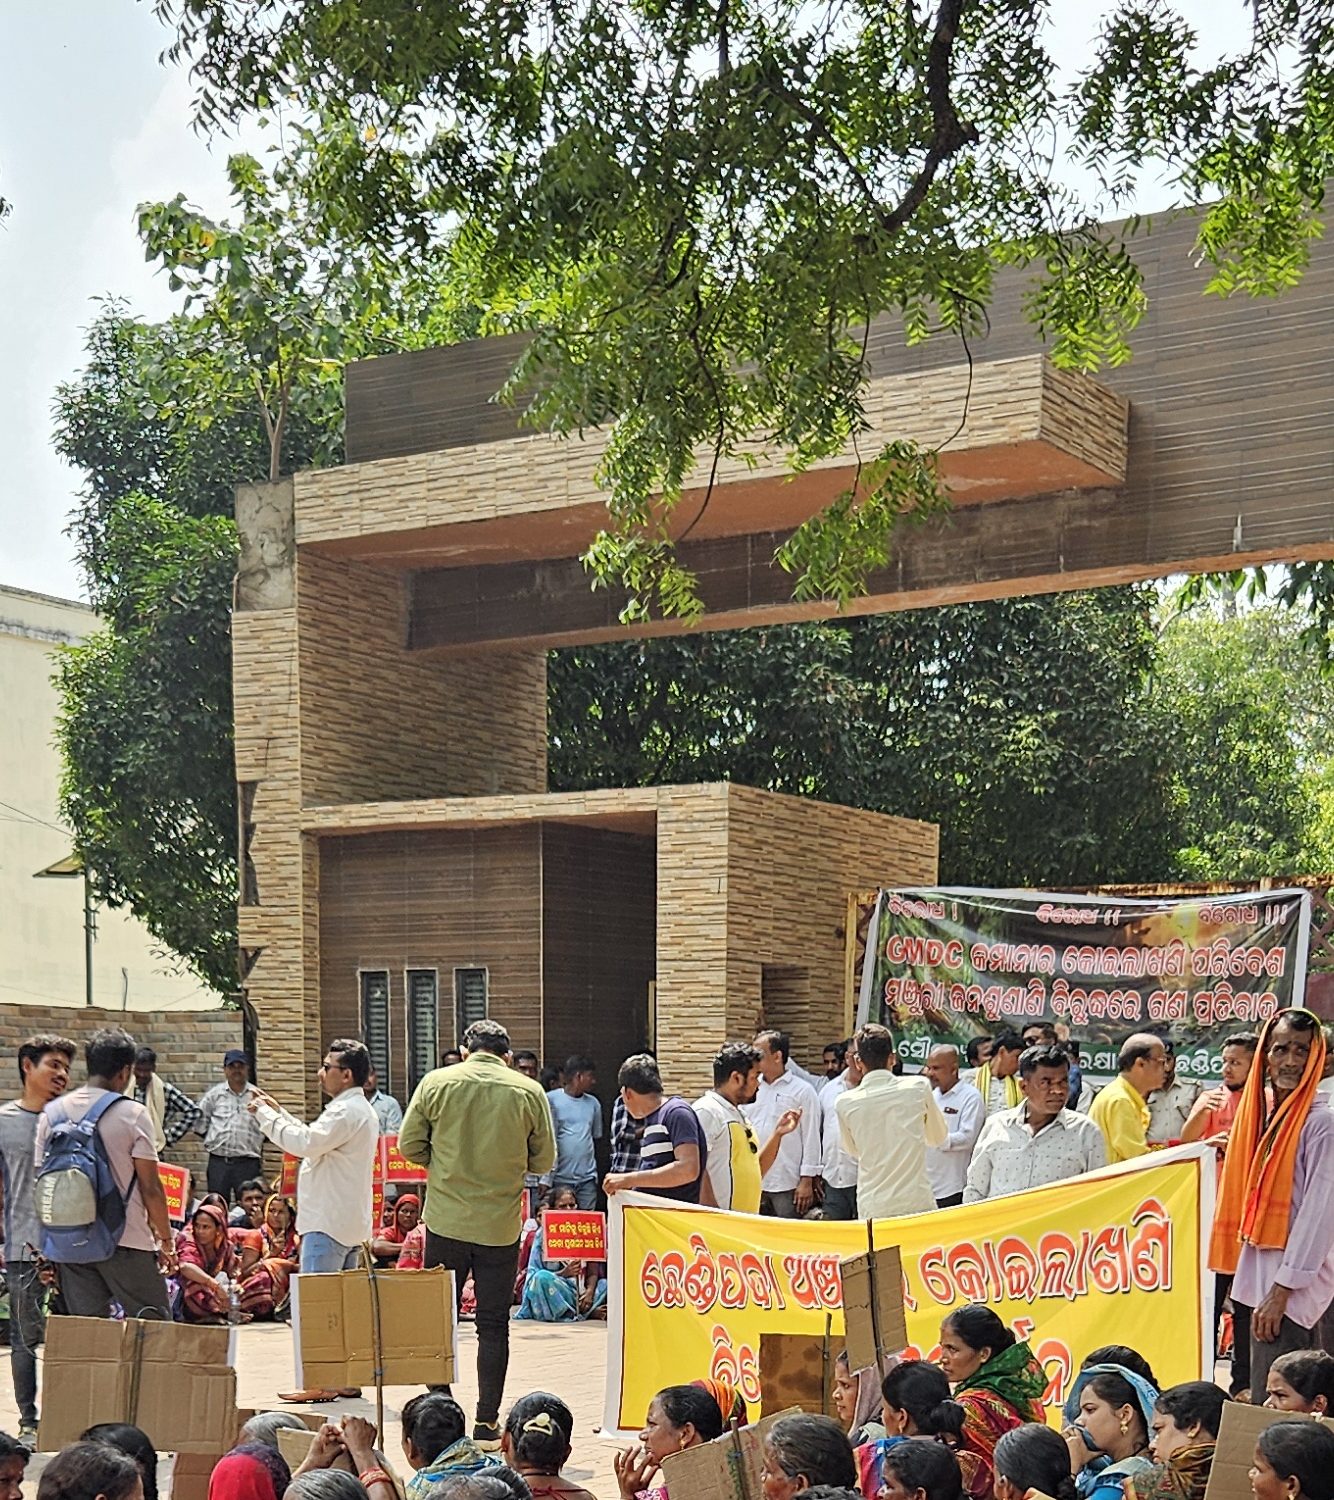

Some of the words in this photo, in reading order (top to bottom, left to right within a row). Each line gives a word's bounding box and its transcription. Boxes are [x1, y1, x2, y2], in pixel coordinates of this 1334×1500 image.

[886, 934, 963, 969] GMDC
[1062, 938, 1186, 977] କୋଇଲାଖଣି
[1191, 937, 1286, 978] ପରିବେଶ
[1148, 990, 1188, 1020] ଗଣ
[42, 1176, 58, 1223] DREAM
[640, 1233, 785, 1314] ଛେଣ୍ଡିପଦା
[919, 1196, 1173, 1305] କୋଇଲାଖଣି
